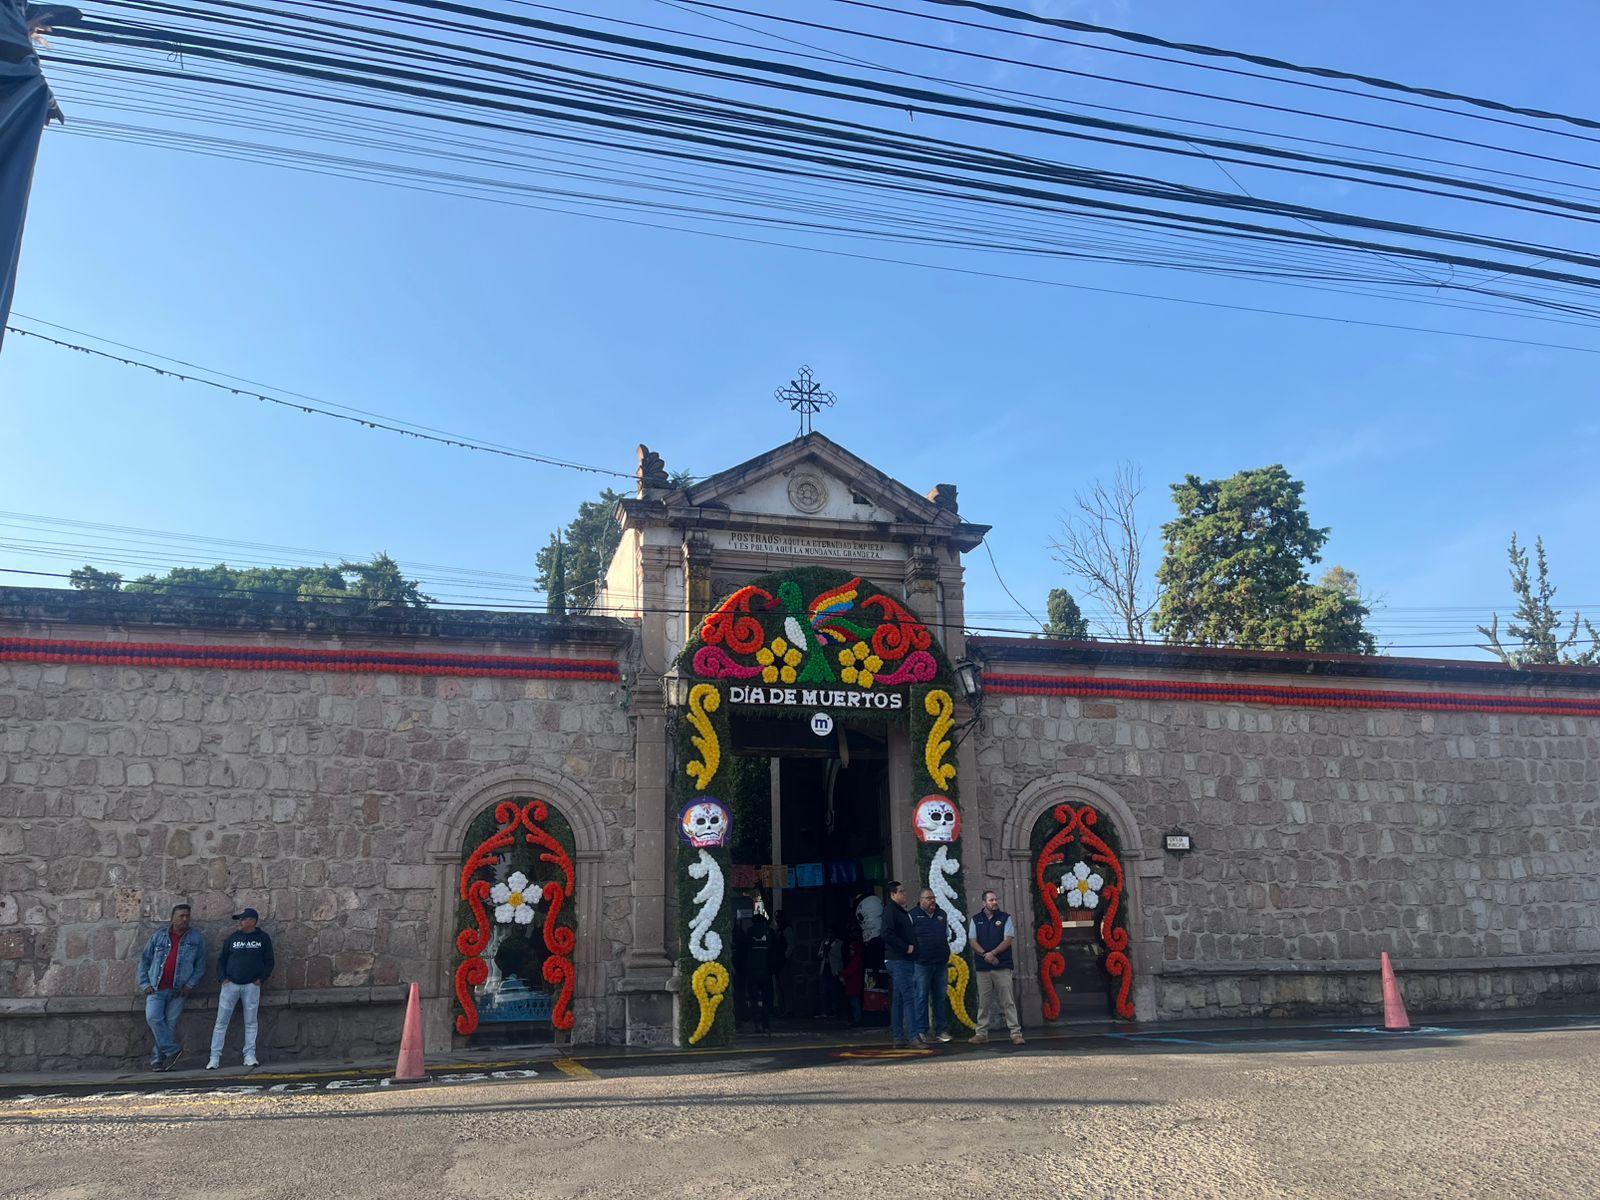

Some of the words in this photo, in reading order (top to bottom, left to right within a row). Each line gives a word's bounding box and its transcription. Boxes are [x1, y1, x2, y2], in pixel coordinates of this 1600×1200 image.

[739, 542, 749, 550] ES
[750, 543, 774, 552] POLVO
[793, 546, 803, 554] LA
[804, 547, 841, 556] MUNDANAL
[801, 539, 810, 547] LA
[812, 540, 852, 550] ETERNIDAD
[853, 543, 885, 551] EMPIEZA
[769, 688, 797, 705] DE
[802, 689, 902, 709] MUERTOS
